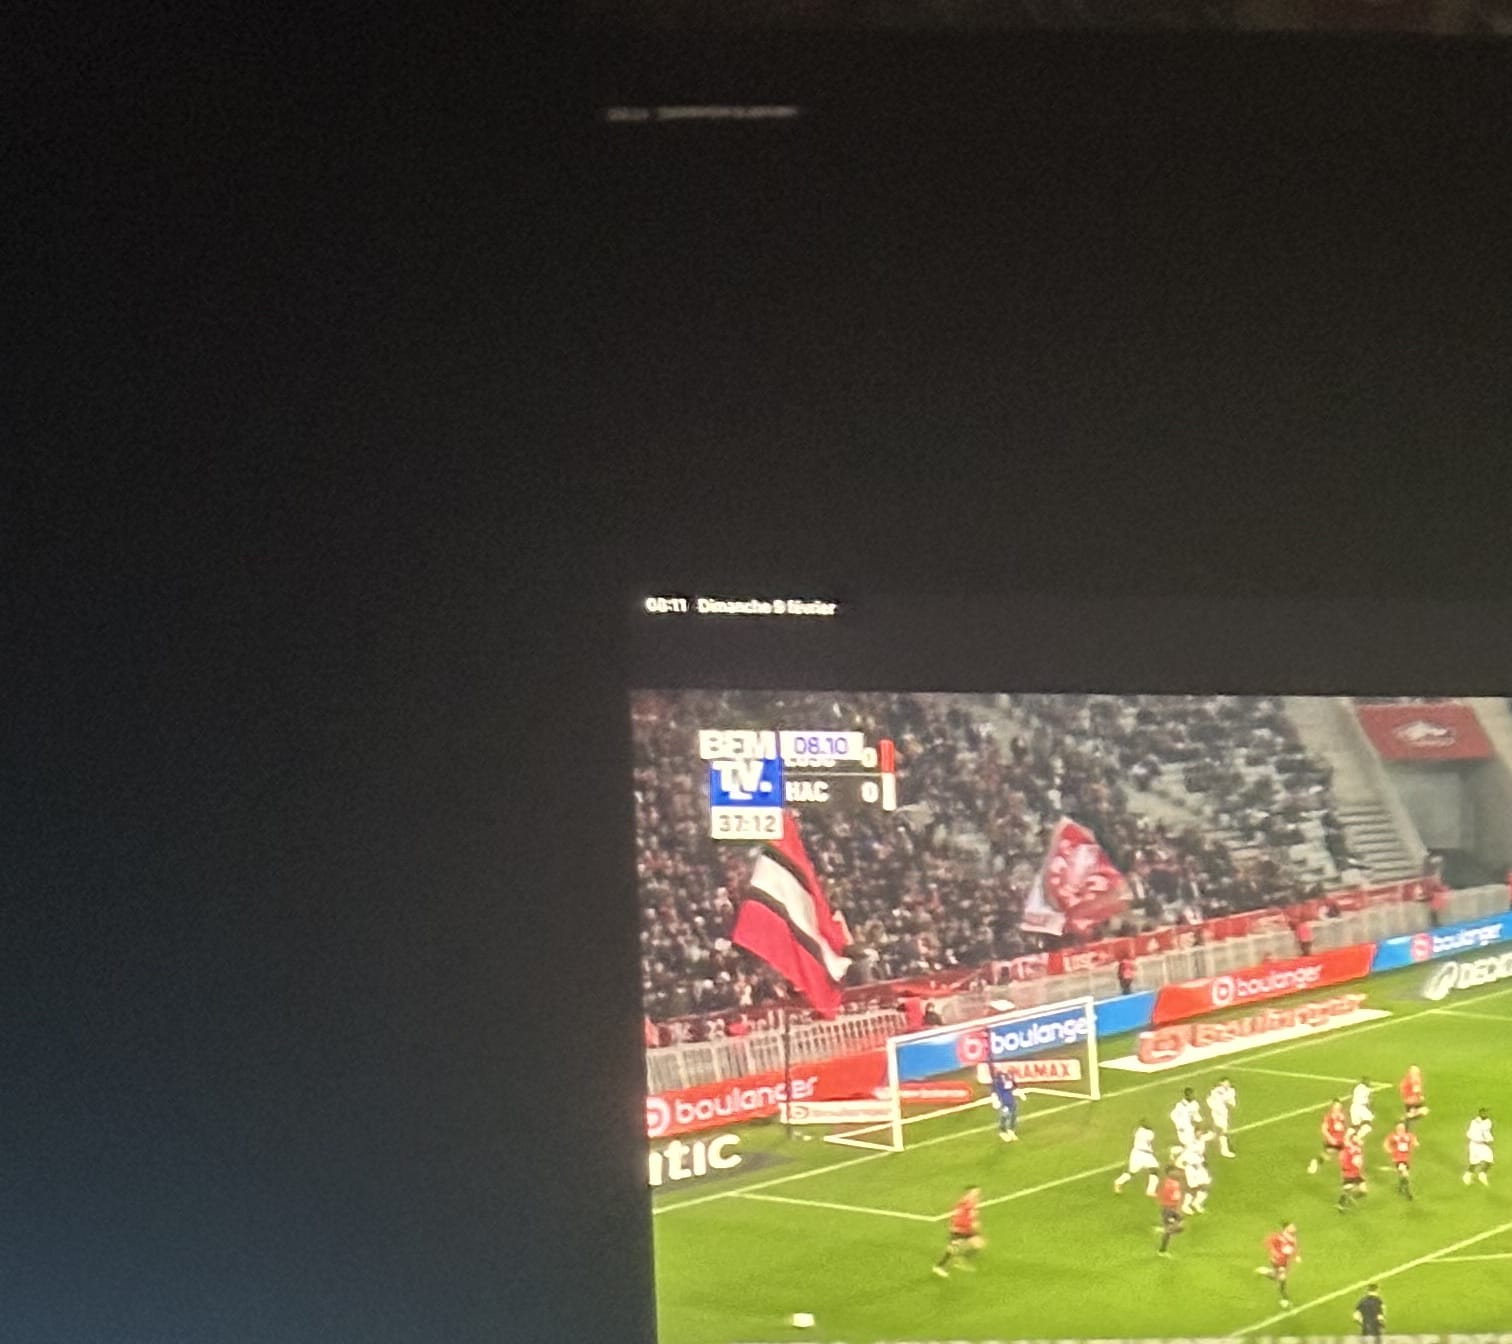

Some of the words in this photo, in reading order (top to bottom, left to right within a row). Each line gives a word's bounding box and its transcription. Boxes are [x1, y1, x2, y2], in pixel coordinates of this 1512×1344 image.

[697, 598, 771, 614] Dimanche
[786, 781, 830, 802] HAC
[861, 782, 878, 803] 0
[1236, 963, 1323, 997] boulanger
